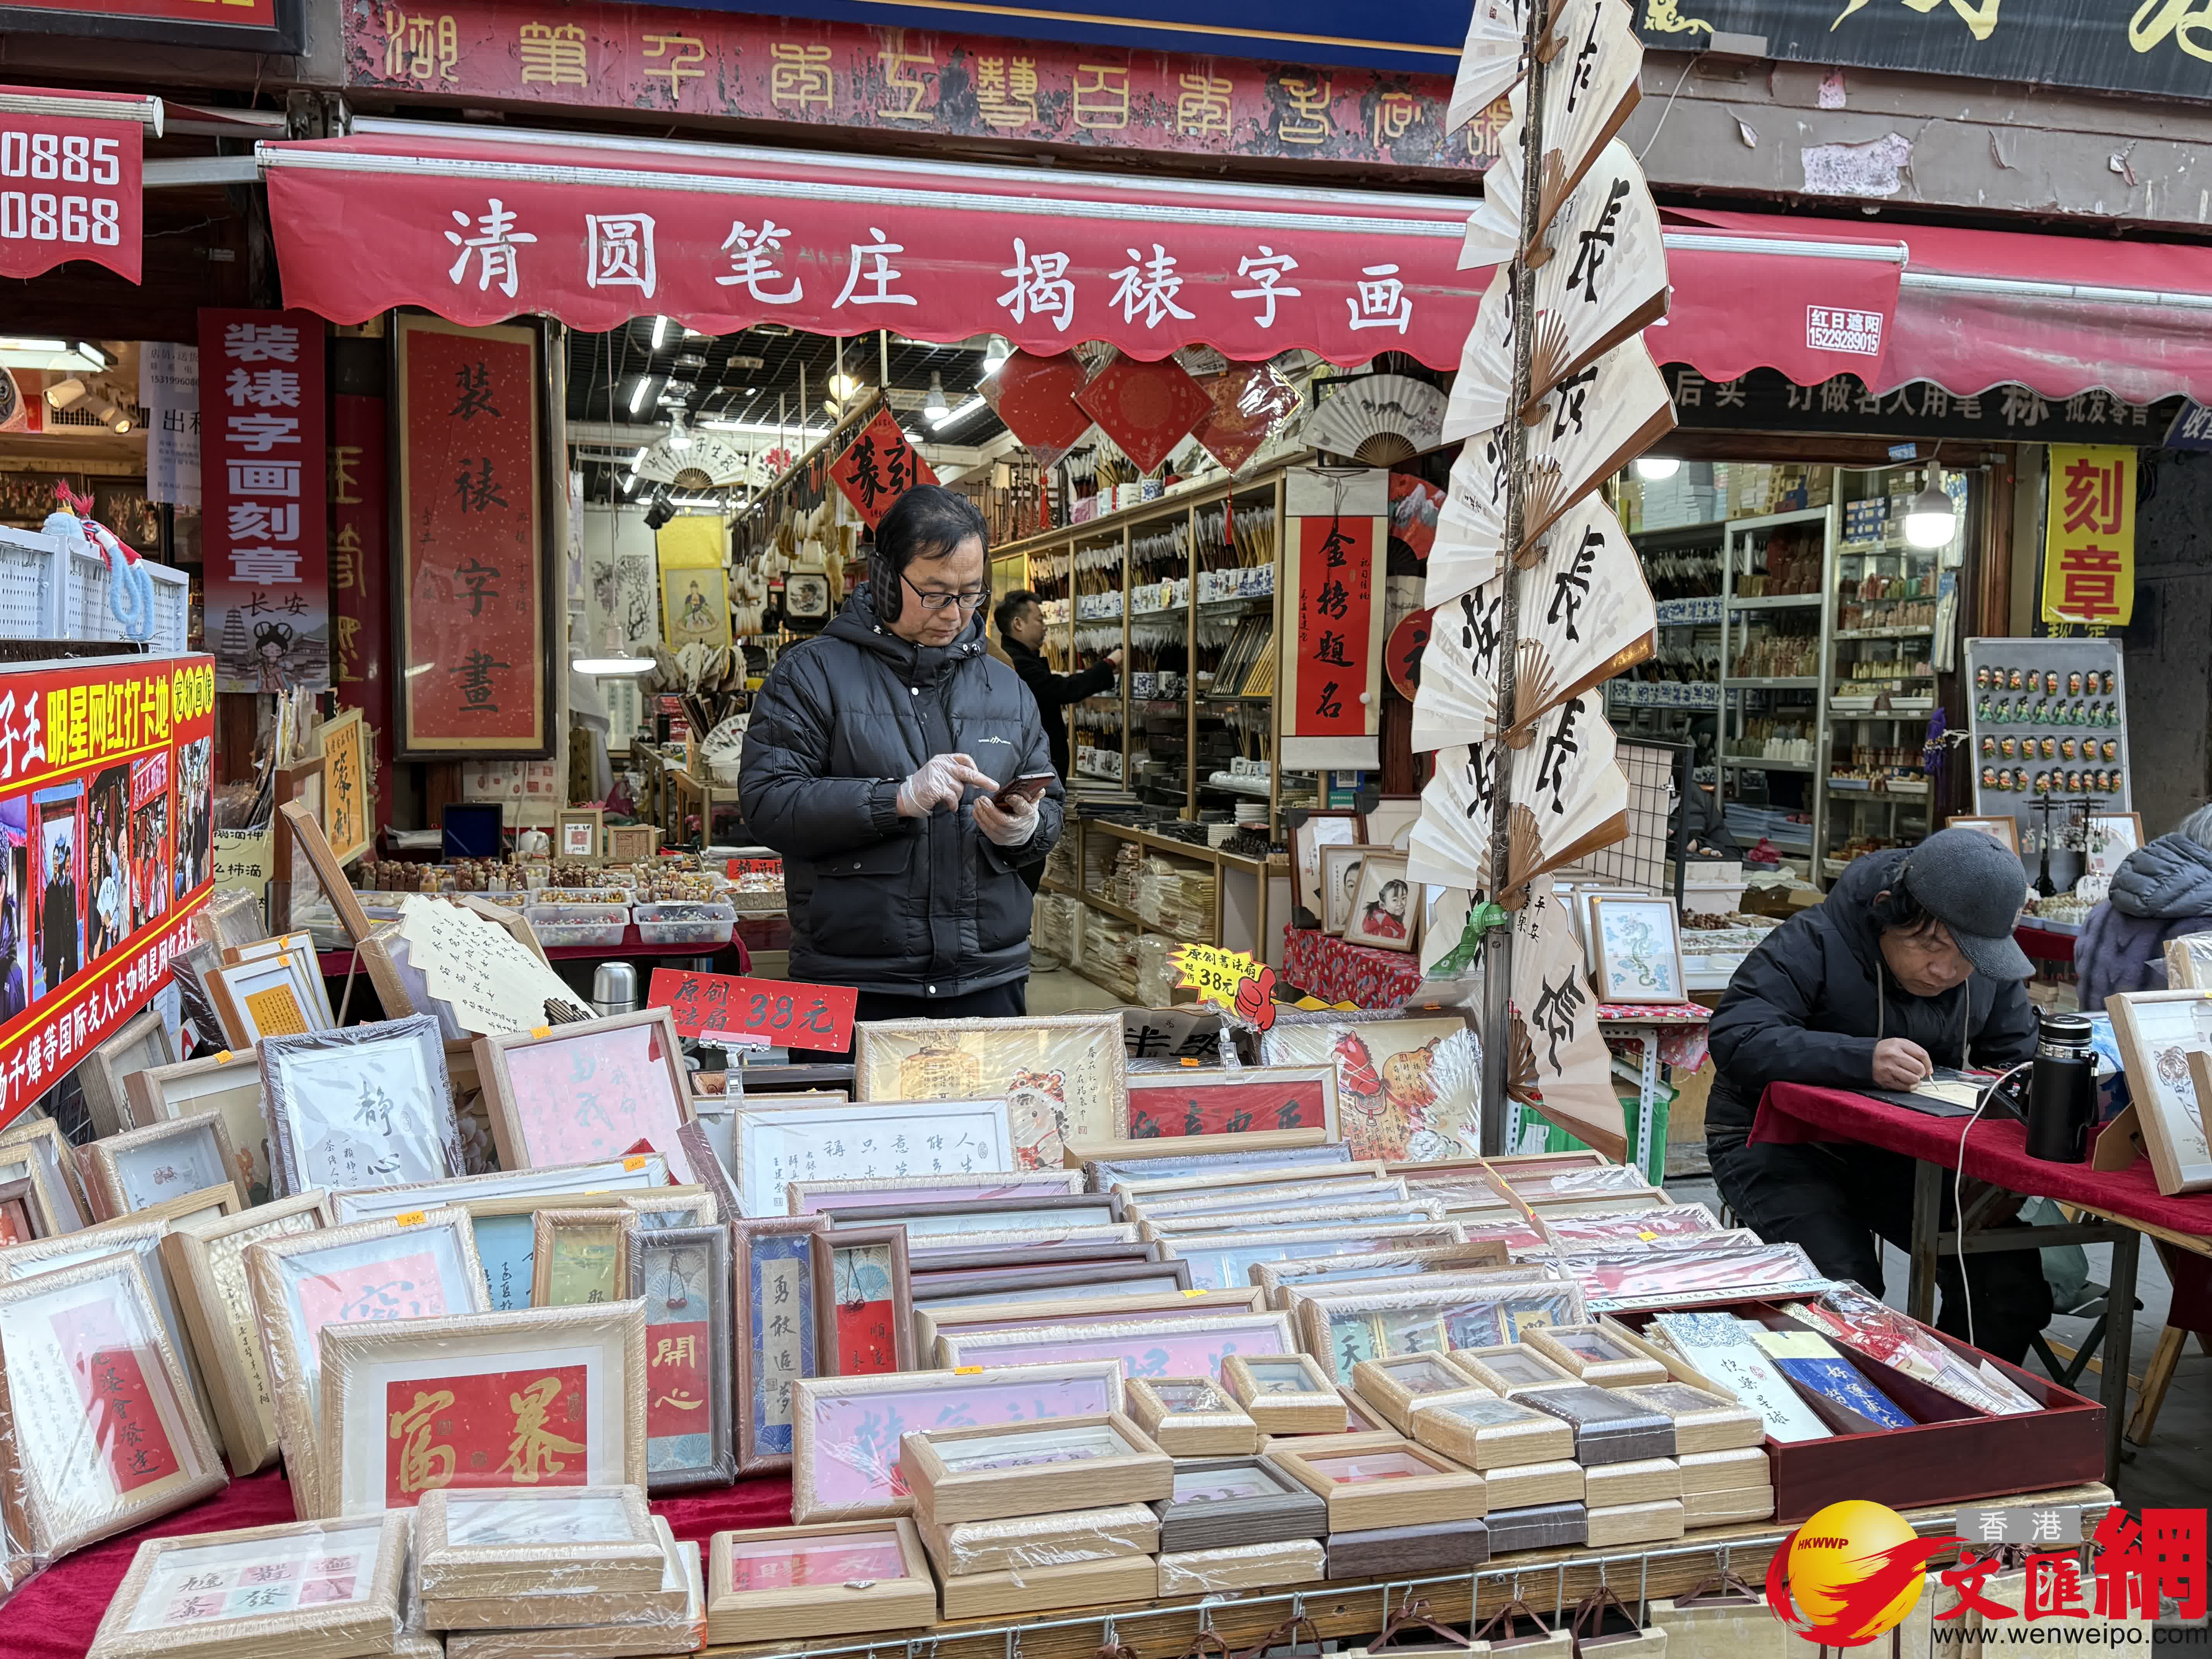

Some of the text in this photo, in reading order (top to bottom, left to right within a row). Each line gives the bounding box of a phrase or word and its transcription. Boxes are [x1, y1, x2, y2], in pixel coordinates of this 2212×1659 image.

[1, 131, 119, 185] 0885
[1, 191, 119, 246] 0868
[444, 198, 1413, 335] 清圆笔庄 揭裱字画
[1811, 309, 1880, 333] 红日遮阳
[224, 323, 304, 586] 装裱字画刻章
[846, 435, 917, 508] 篆刻
[2057, 458, 2124, 620] 刻章
[240, 592, 309, 618] 长安
[1313, 530, 1355, 719] 金榜題名
[47, 675, 169, 768] 明星网红打卡地
[173, 672, 213, 715] 宠物画像
[745, 994, 834, 1033] 38元
[1199, 968, 1235, 996] 38元
[661, 1003, 728, 1030] 法扇
[652, 1334, 704, 1410] 開心
[768, 1274, 797, 1413] 勇敢追夢
